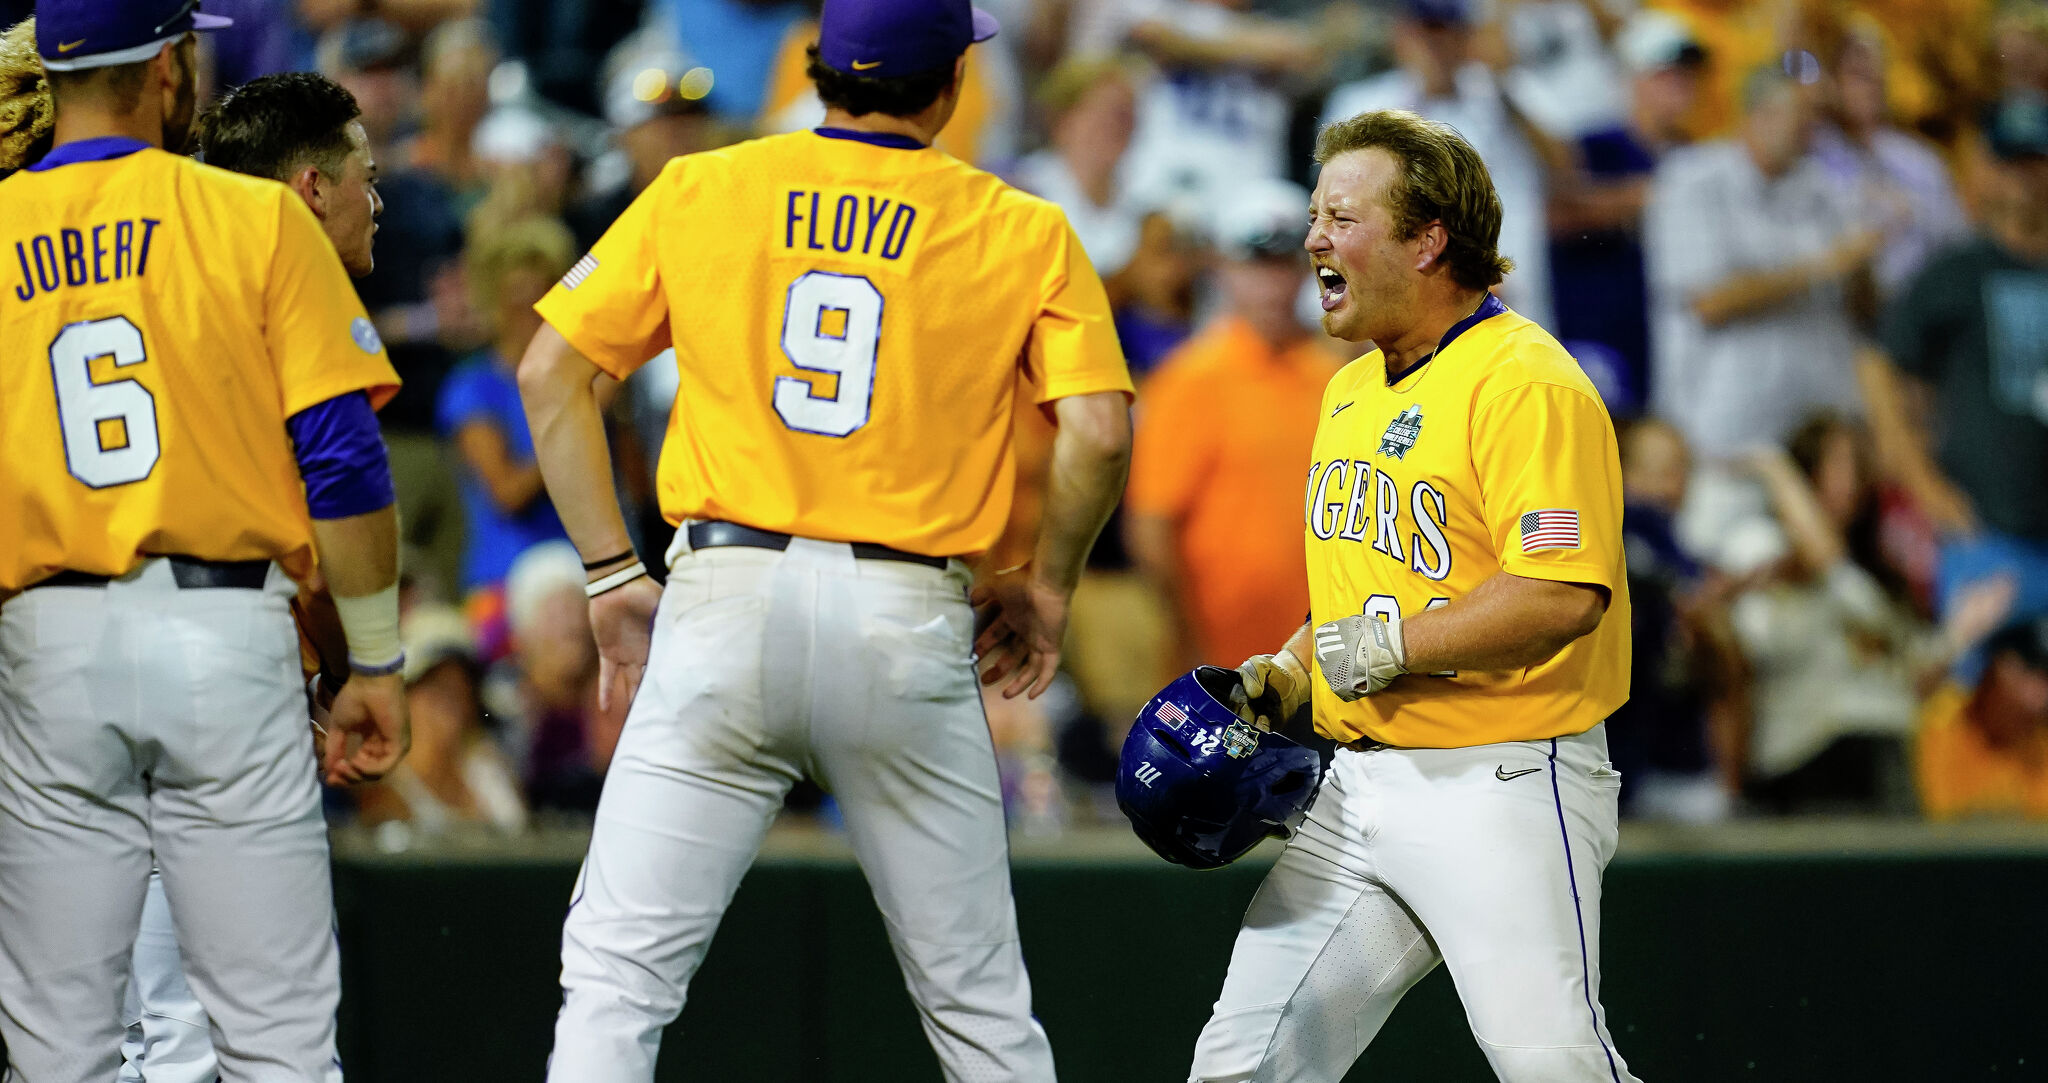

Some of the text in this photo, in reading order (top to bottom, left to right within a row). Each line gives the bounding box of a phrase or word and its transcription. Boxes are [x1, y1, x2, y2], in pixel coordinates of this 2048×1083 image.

[15, 218, 161, 302] JOBERT
[786, 191, 916, 260] FLOYD
[48, 314, 161, 490] 6
[771, 269, 885, 439] 9
[1305, 458, 1452, 581] IGERS
[1190, 727, 1221, 757] 24
